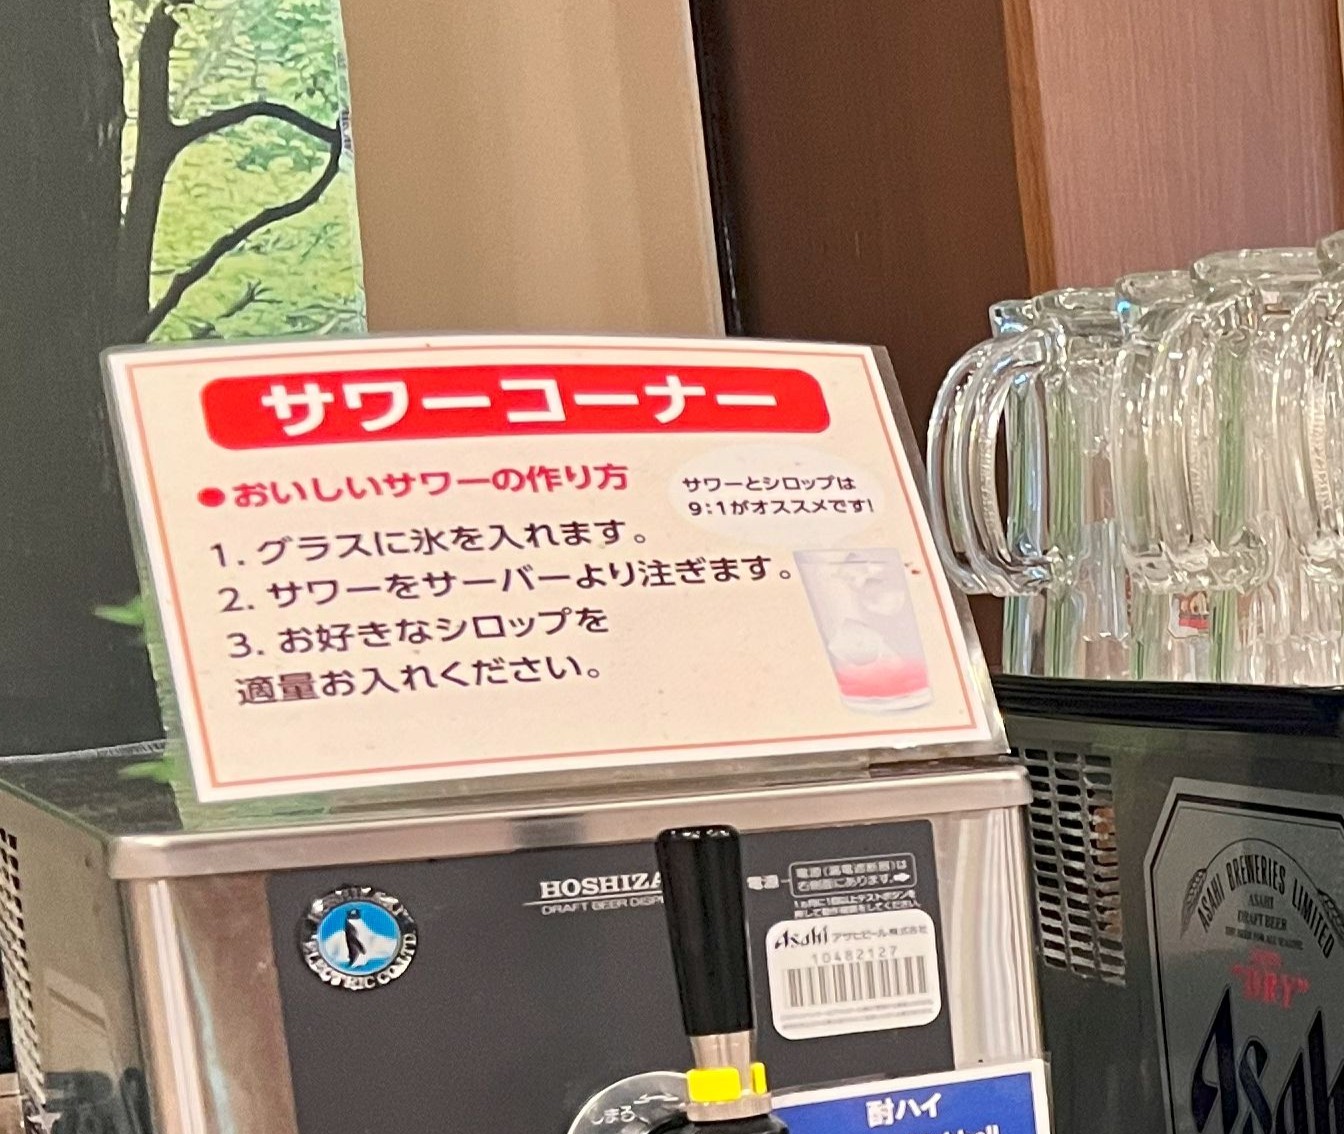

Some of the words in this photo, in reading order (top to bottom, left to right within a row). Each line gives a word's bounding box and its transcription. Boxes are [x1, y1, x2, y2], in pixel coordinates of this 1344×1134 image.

[261, 374, 778, 437] サワーコーナー
[232, 462, 629, 509] おいしいサワーの作り方
[682, 474, 857, 492] サワーとシロップは
[210, 541, 245, 568] 1.
[257, 518, 651, 565] グラスに氷を入れます。
[218, 587, 255, 614] 2.
[267, 554, 793, 610] サワーをサーバーより注ぎます。
[228, 631, 265, 659] 3.
[279, 604, 610, 655] お好きなシロップを
[235, 653, 604, 708] 適量お入れください。
[540, 871, 662, 899] HOSHIZA
[1197, 872, 1226, 933] ASAHI
[1225, 854, 1286, 896] BREWERIES
[1291, 877, 1336, 959] LIMITED
[541, 901, 588, 916] DRAFT
[592, 898, 628, 911] BEER
[774, 925, 829, 949] Asahi
[812, 945, 898, 964] 10482127
[591, 1104, 636, 1125] しまる
[866, 1091, 942, 1130] 酎ハイ
